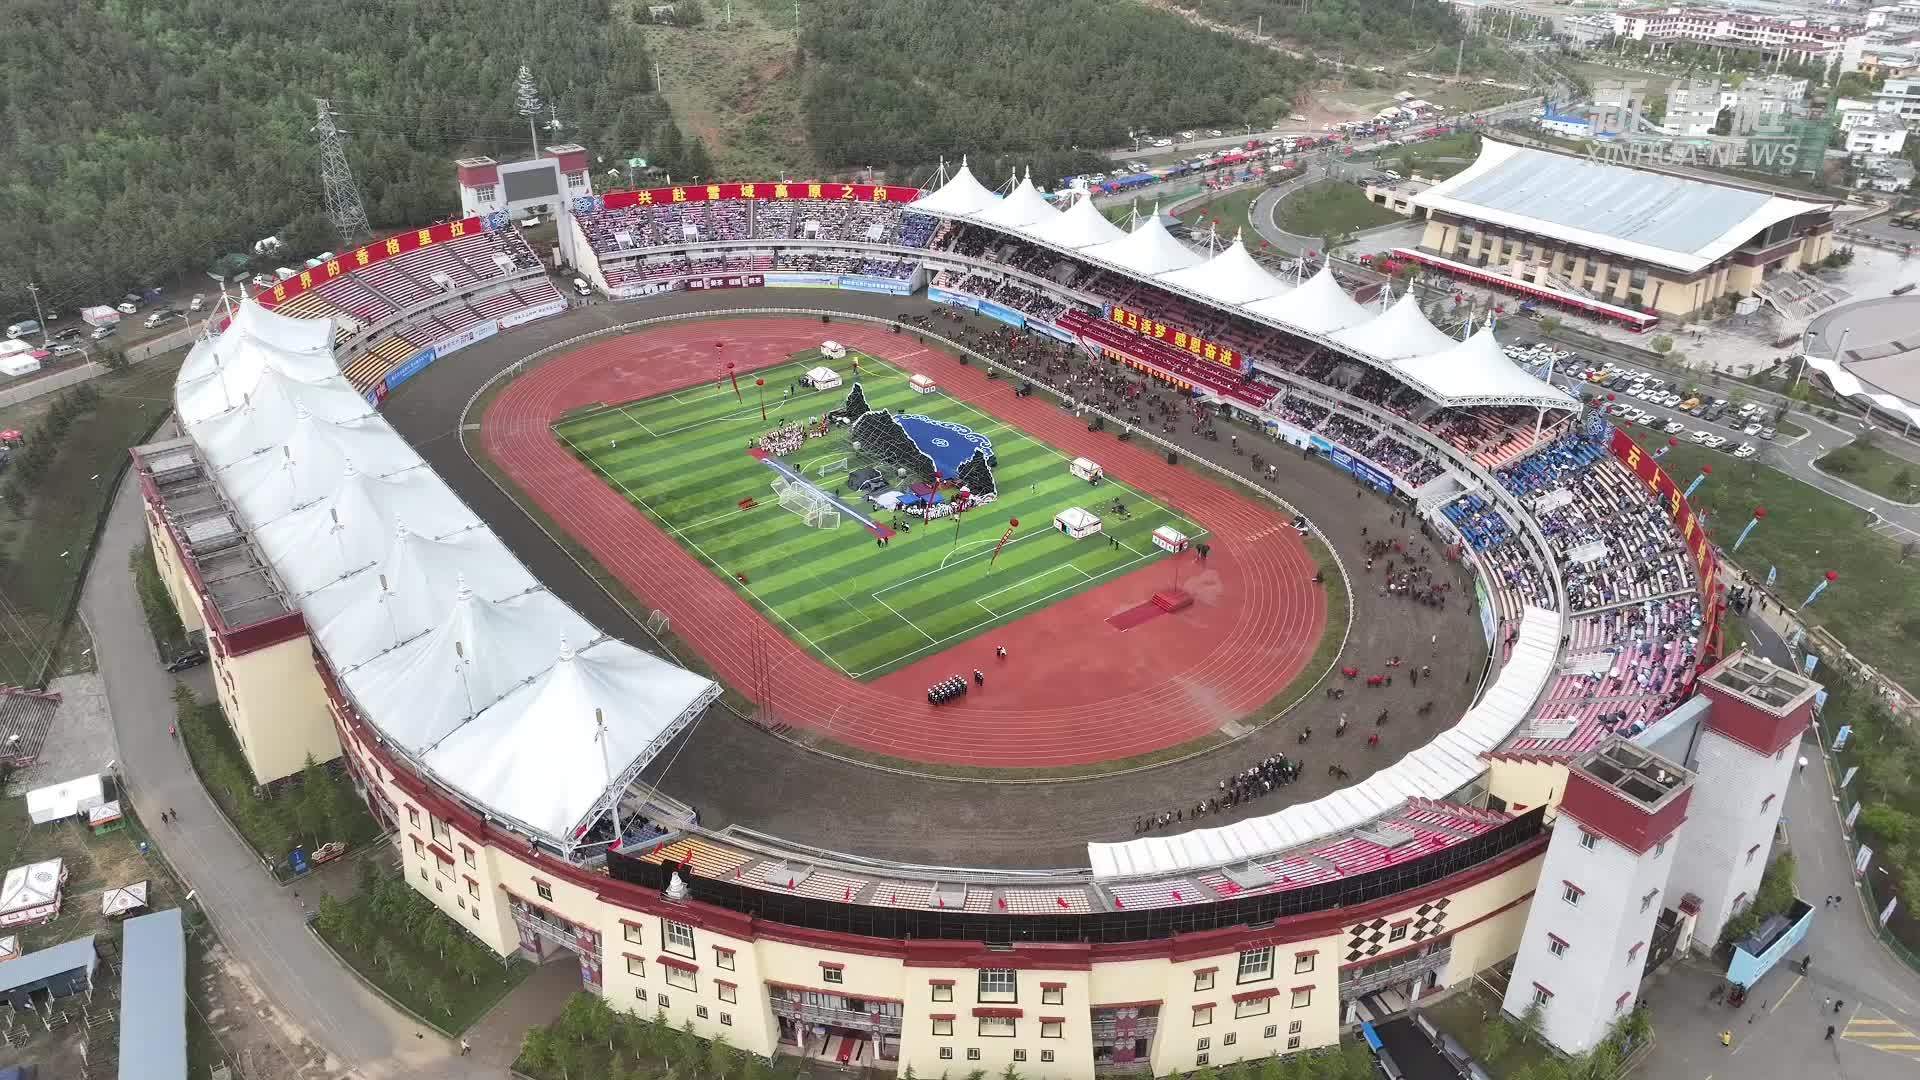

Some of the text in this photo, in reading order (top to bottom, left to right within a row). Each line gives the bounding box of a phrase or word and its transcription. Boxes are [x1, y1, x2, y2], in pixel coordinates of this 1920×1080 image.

[638, 184, 887, 205] 共赴雪域高原之约
[273, 221, 465, 302] 世界的香格里拉
